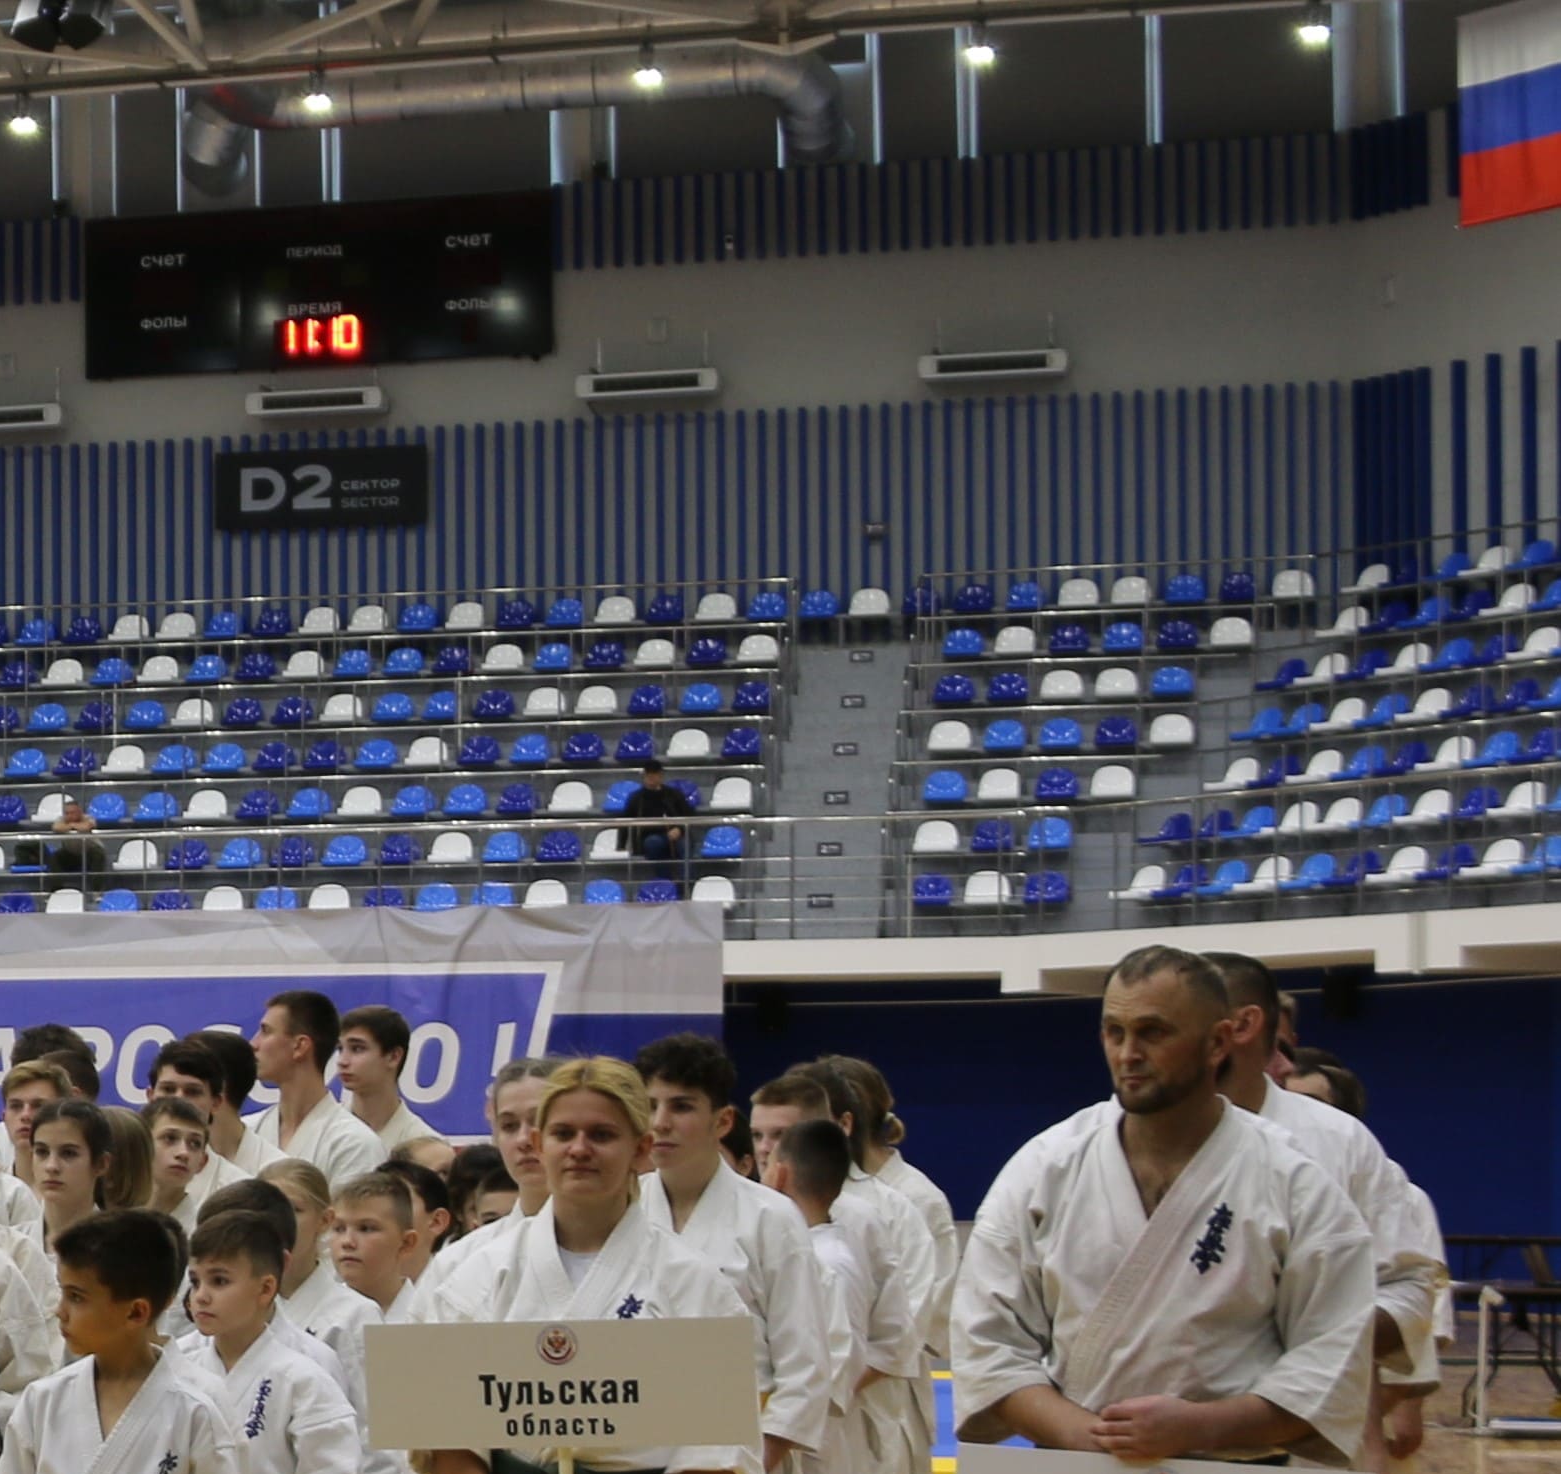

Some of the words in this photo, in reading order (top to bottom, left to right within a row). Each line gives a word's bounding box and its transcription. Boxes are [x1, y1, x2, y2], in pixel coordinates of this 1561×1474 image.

[288, 302, 342, 315] ВРЕМЯ
[240, 464, 332, 512] D2
[340, 478, 400, 491] СЕКТОР
[479, 1374, 640, 1412] Тульская
[506, 1413, 616, 1437] область
